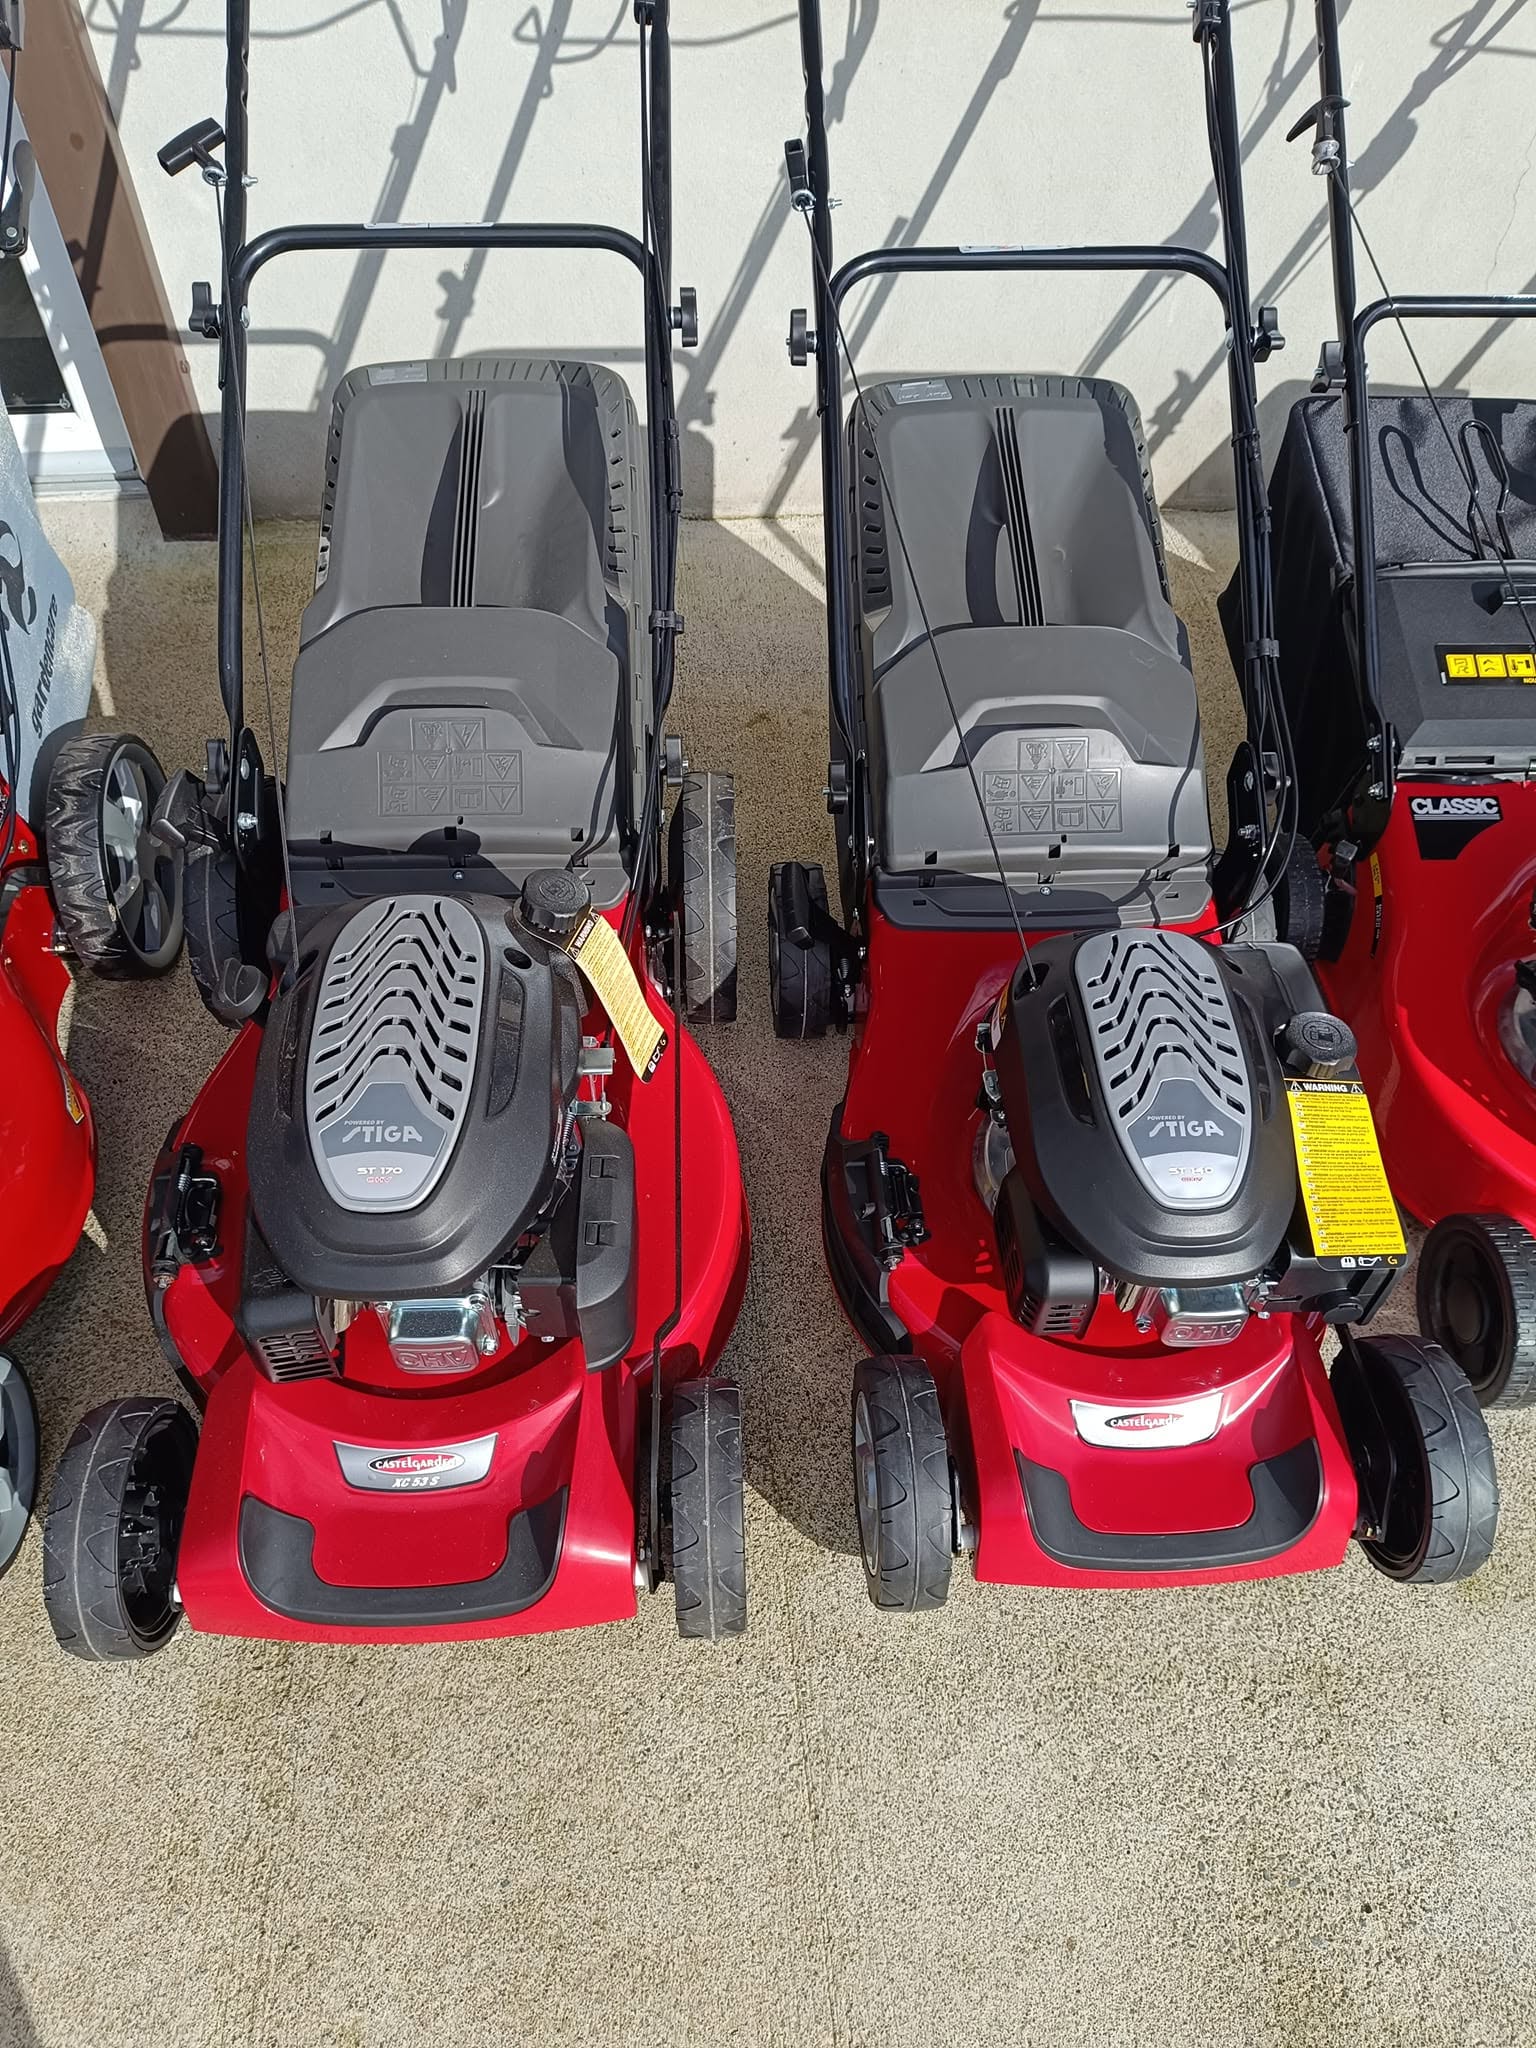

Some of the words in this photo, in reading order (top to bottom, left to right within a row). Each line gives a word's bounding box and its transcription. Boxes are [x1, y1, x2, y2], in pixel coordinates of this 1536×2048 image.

[31, 593, 58, 739] gardencare
[1411, 797, 1499, 814] CLASSIC
[574, 918, 595, 947] WARNING
[1302, 1082, 1348, 1093] WARNING
[342, 1125, 423, 1143] STIGA
[1149, 1119, 1225, 1138] STIGA
[357, 1166, 377, 1175] ST
[380, 1166, 403, 1175] 170
[1168, 1322, 1242, 1340] OHV
[392, 1477, 411, 1488] XC
[412, 1476, 428, 1487] 53
[429, 1475, 441, 1486] S
